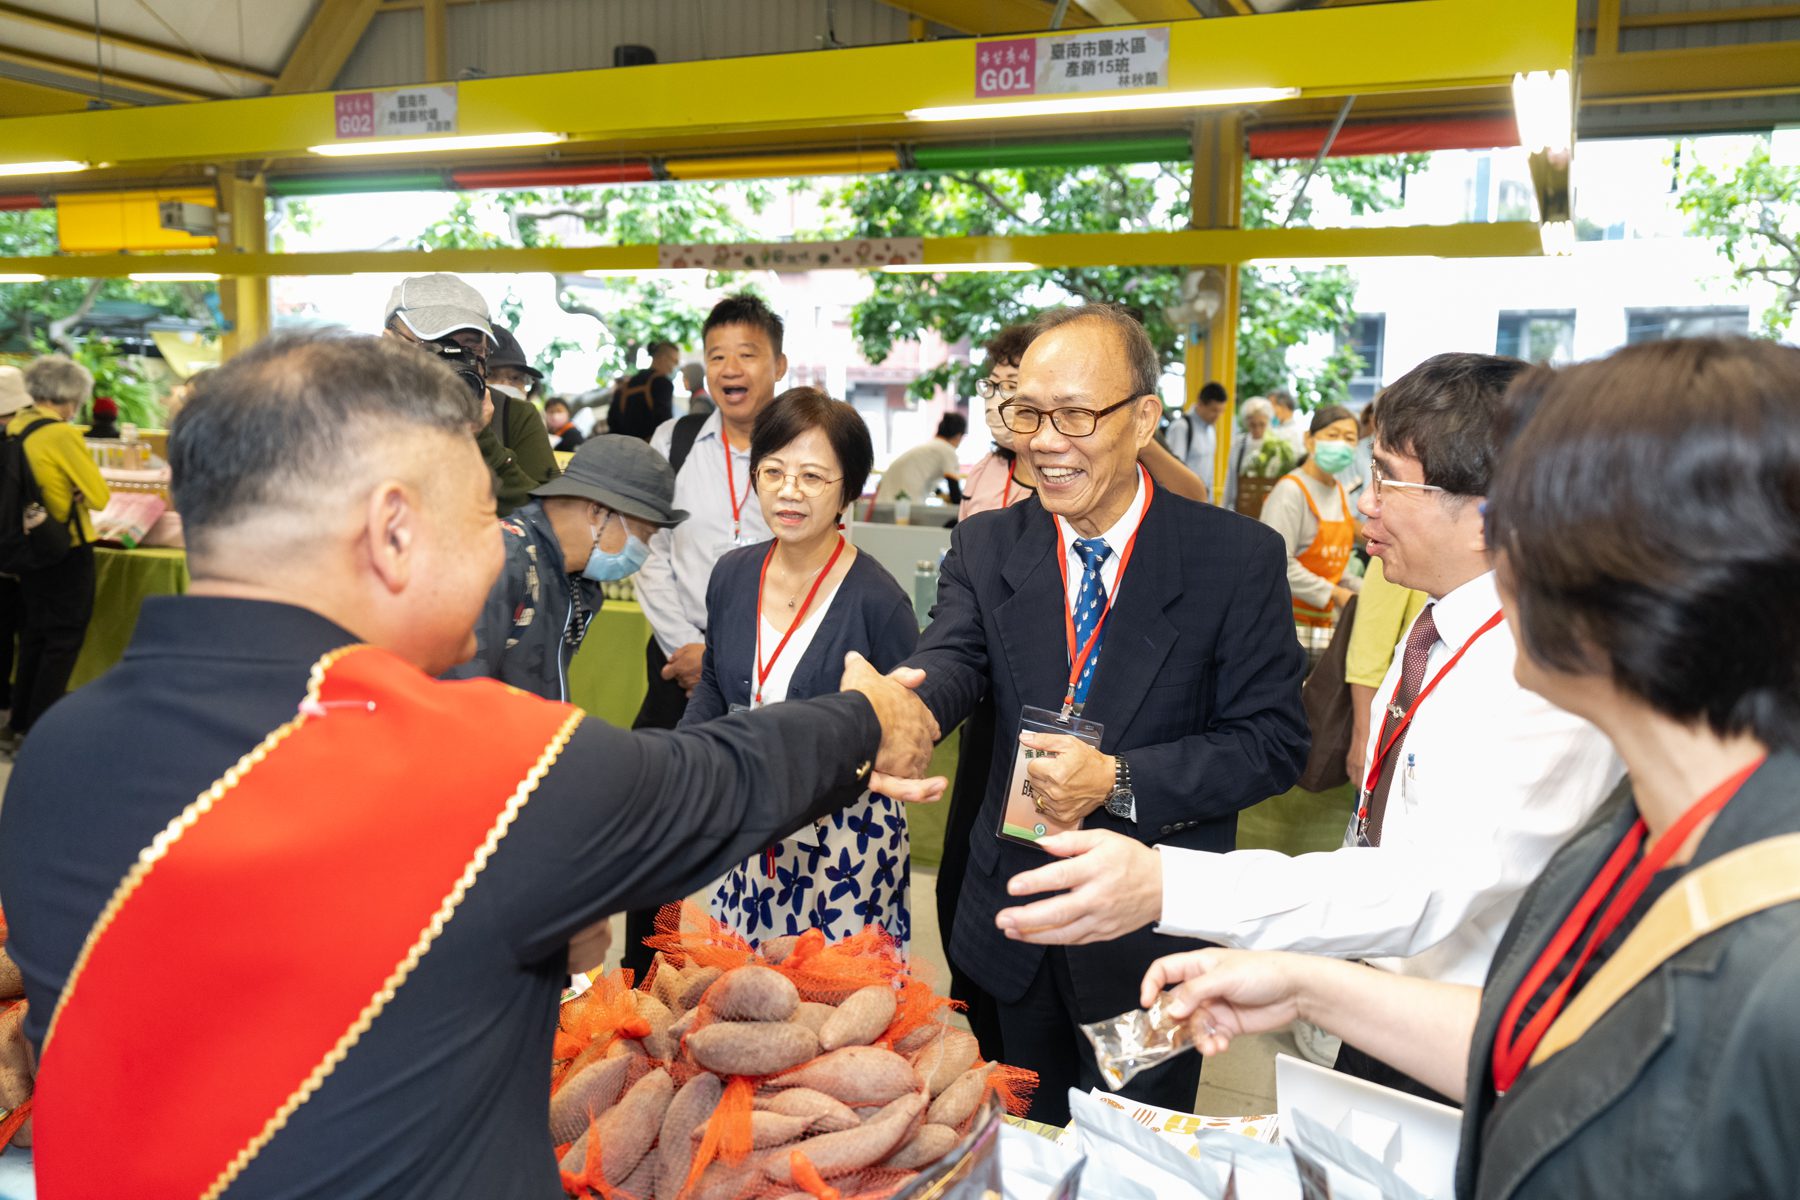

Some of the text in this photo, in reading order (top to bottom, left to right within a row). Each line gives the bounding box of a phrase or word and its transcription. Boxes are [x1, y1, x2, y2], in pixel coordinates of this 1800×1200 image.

[1051, 37, 1146, 60] 臺南市鹽水區
[1065, 57, 1130, 77] 產銷15班
[980, 67, 1031, 92] G01
[340, 115, 371, 133] G02
